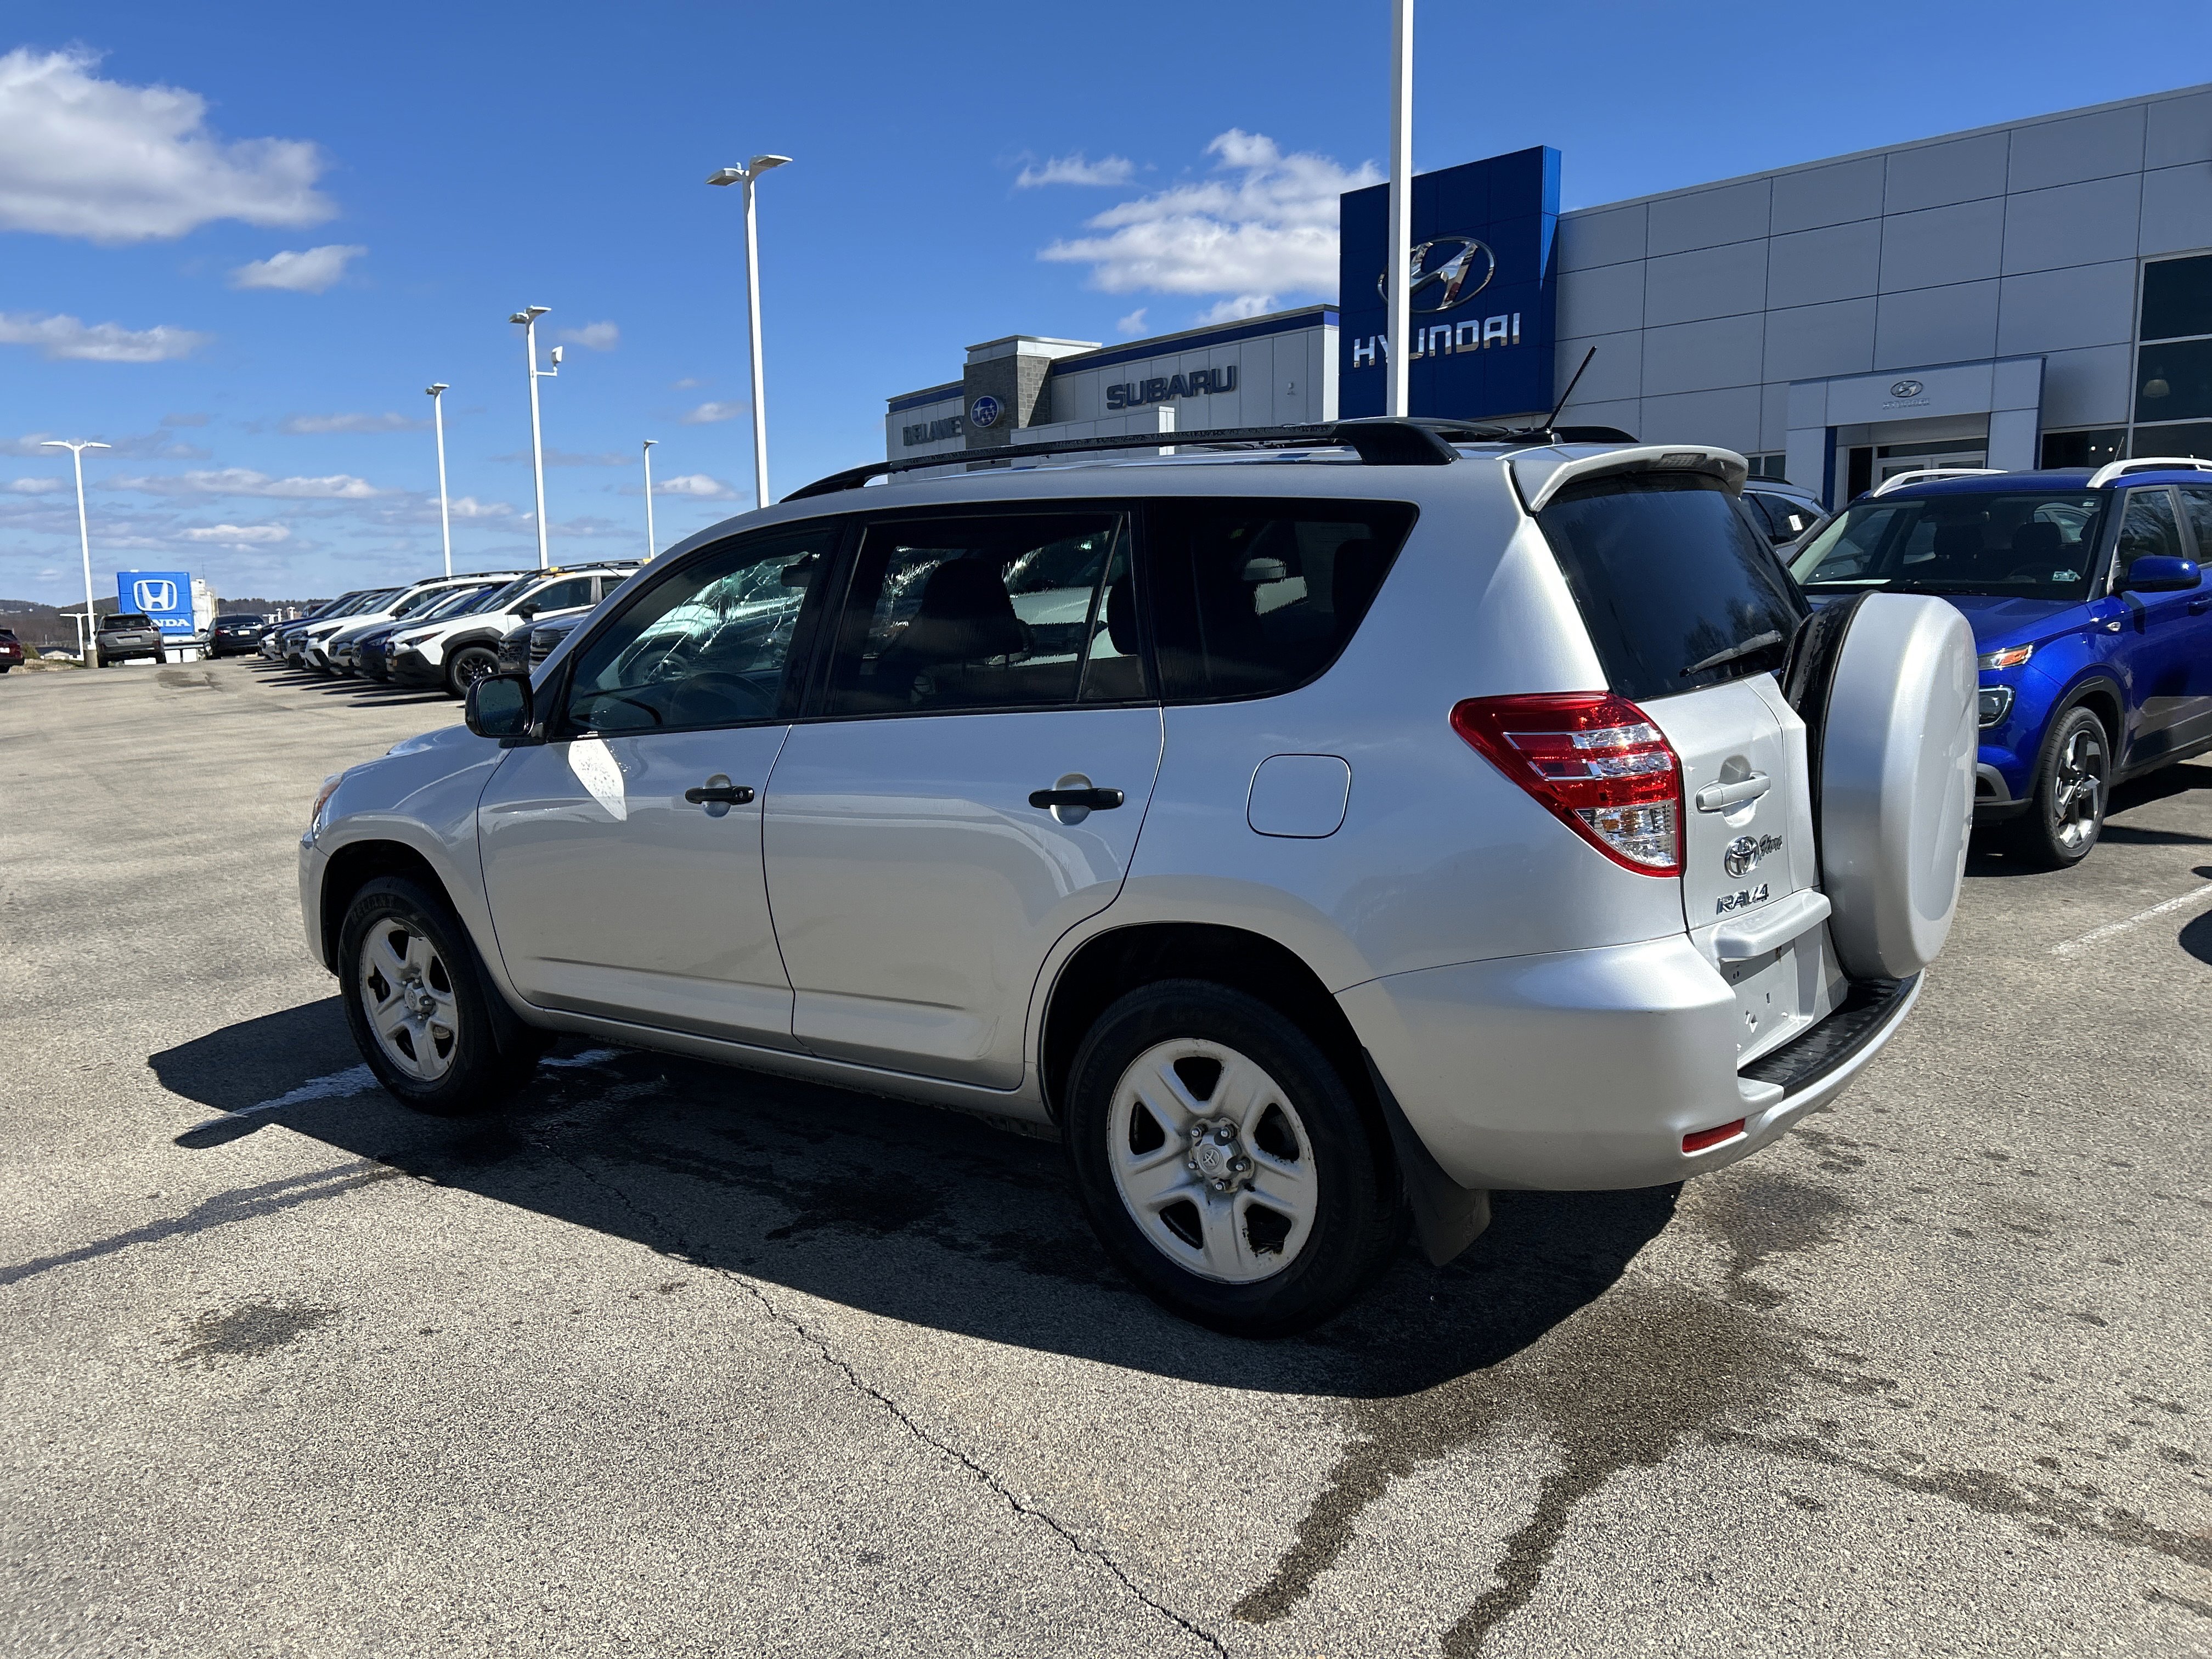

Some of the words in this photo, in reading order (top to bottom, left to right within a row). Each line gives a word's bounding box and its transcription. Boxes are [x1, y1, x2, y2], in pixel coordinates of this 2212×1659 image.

[1107, 365, 1236, 410] SUBARU
[151, 618, 191, 627] NDA
[1716, 883, 1769, 915] RAV4
